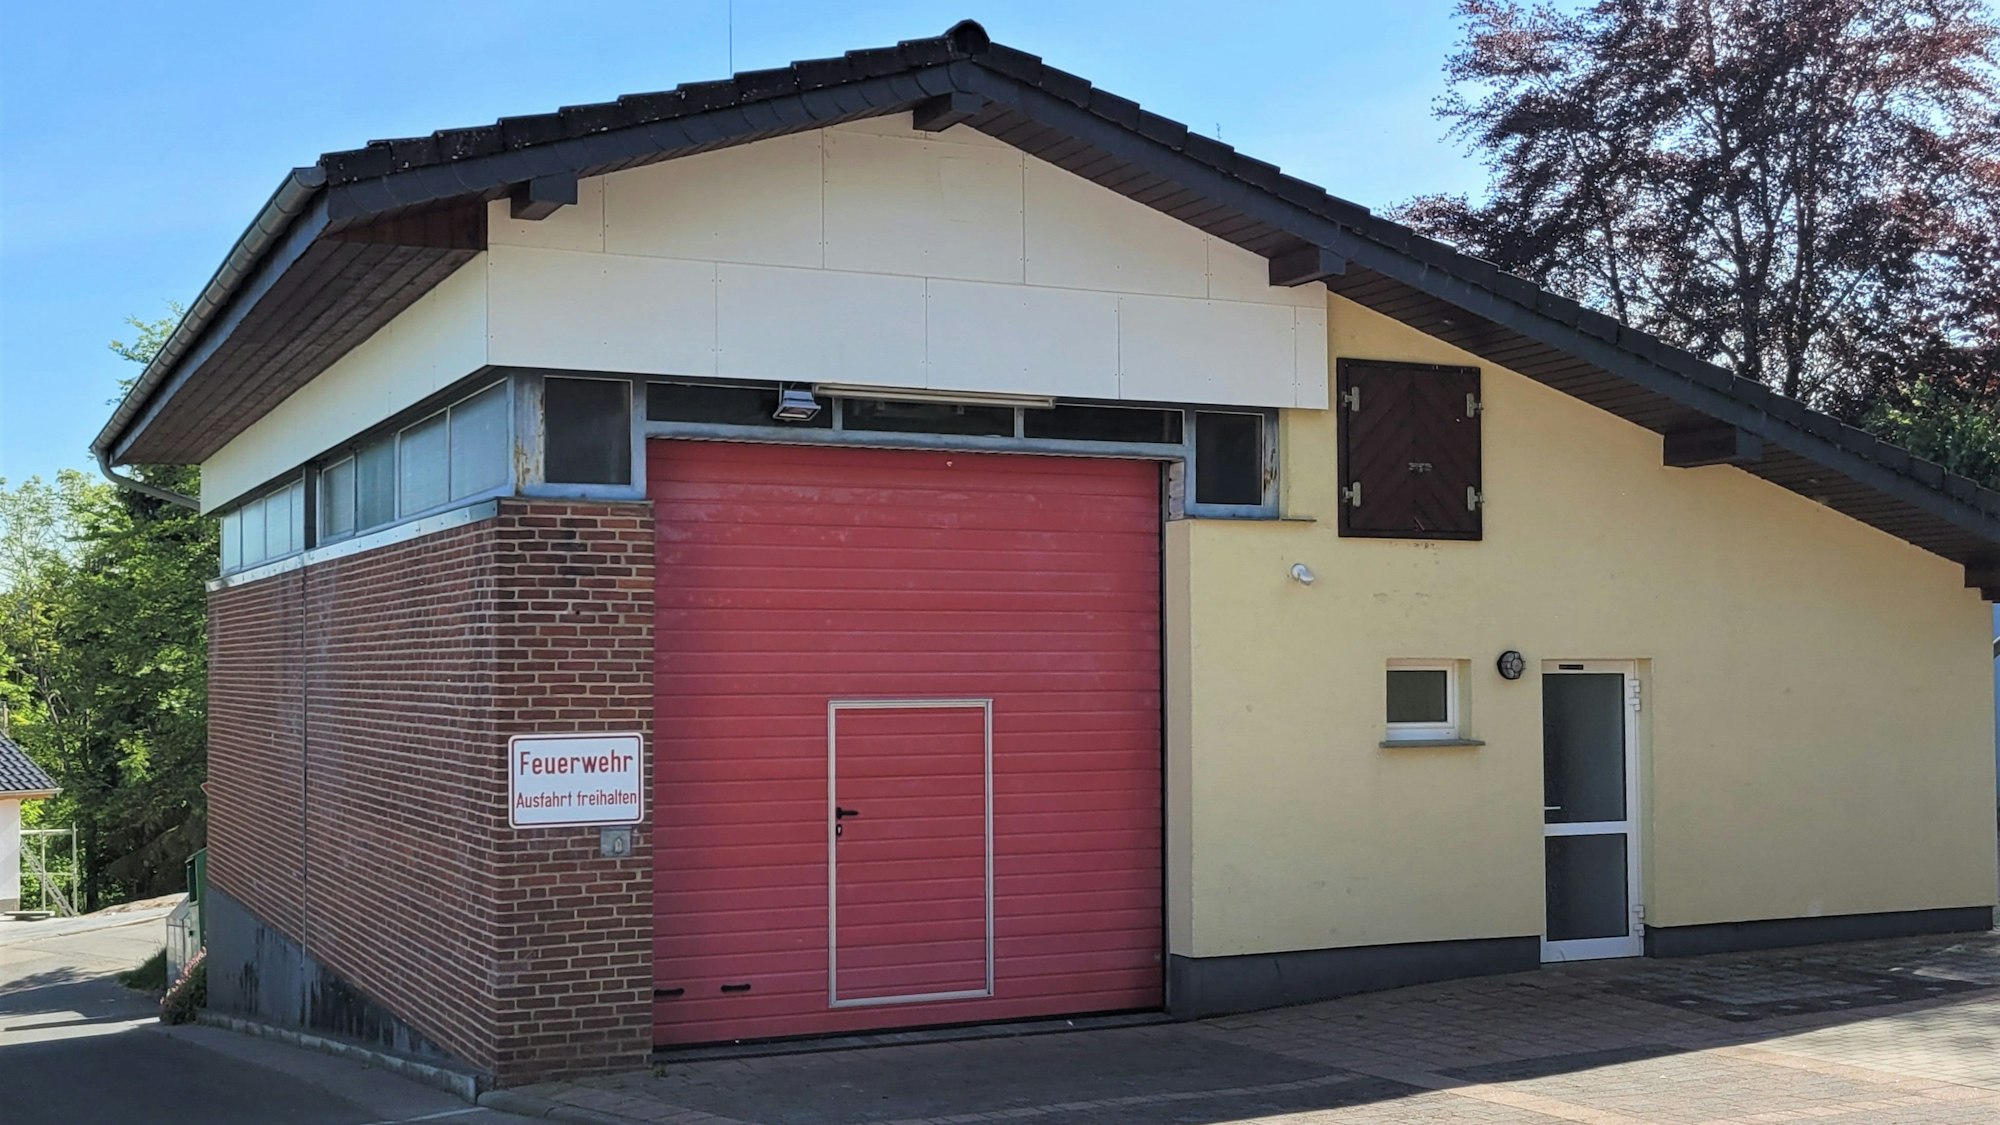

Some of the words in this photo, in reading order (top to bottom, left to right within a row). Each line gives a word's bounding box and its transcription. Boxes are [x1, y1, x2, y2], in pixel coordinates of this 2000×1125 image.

[520, 749, 633, 775] Feuerwehr
[516, 791, 572, 808] Ausfahrt
[577, 789, 637, 806] freihalten
